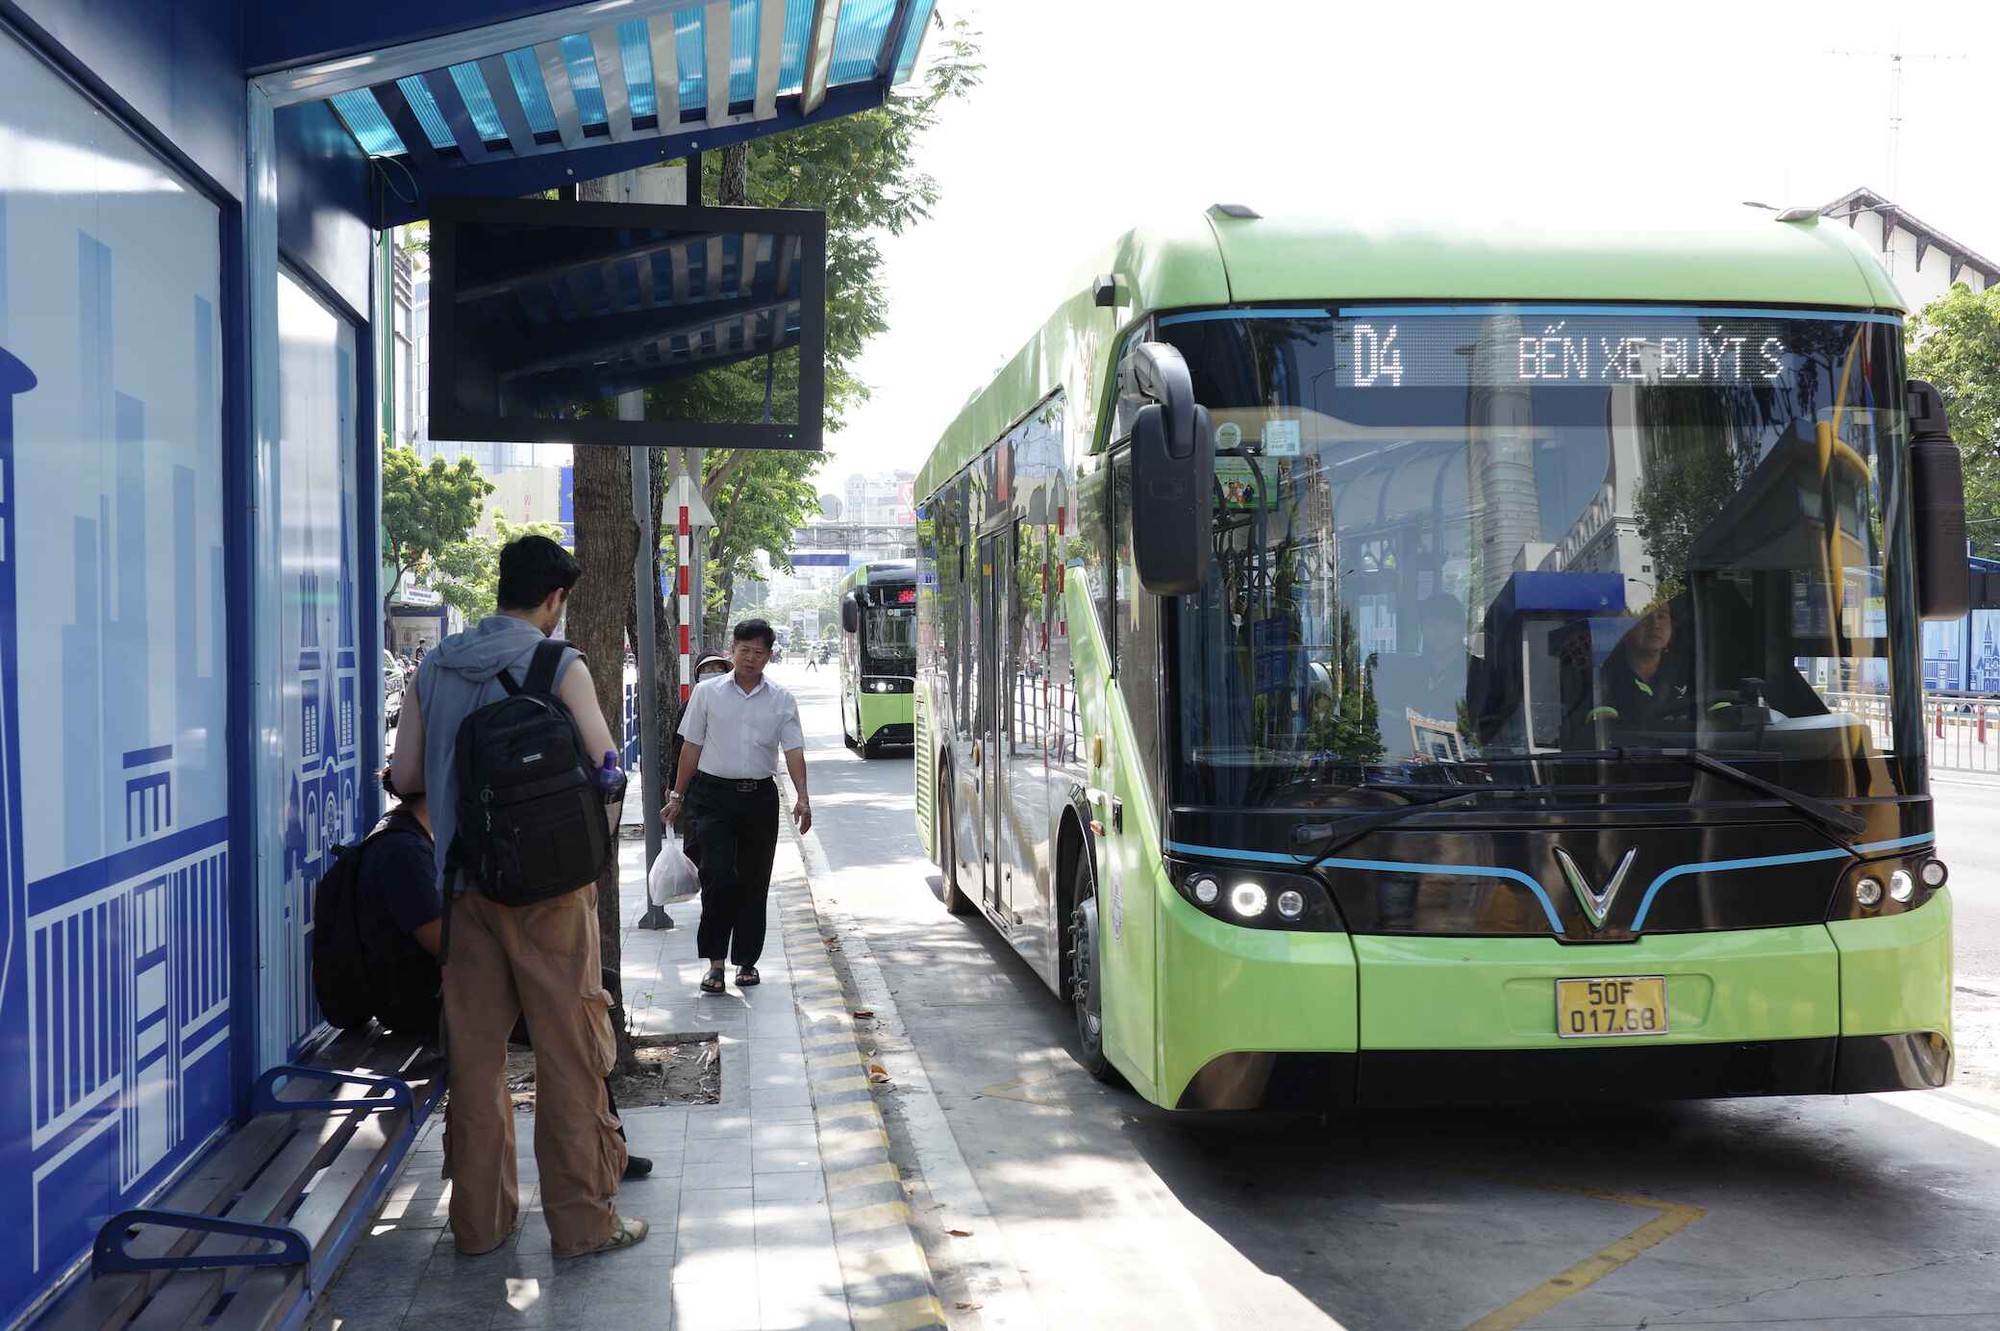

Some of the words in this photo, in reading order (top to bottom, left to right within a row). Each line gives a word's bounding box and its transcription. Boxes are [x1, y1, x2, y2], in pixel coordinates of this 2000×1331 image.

[1353, 324, 1403, 387] D4
[1519, 320, 1588, 379] BẾN
[1601, 338, 1646, 378] XE
[1660, 324, 1747, 379] BUÝT
[1759, 337, 1784, 378] S
[1588, 982, 1634, 1005] 50F
